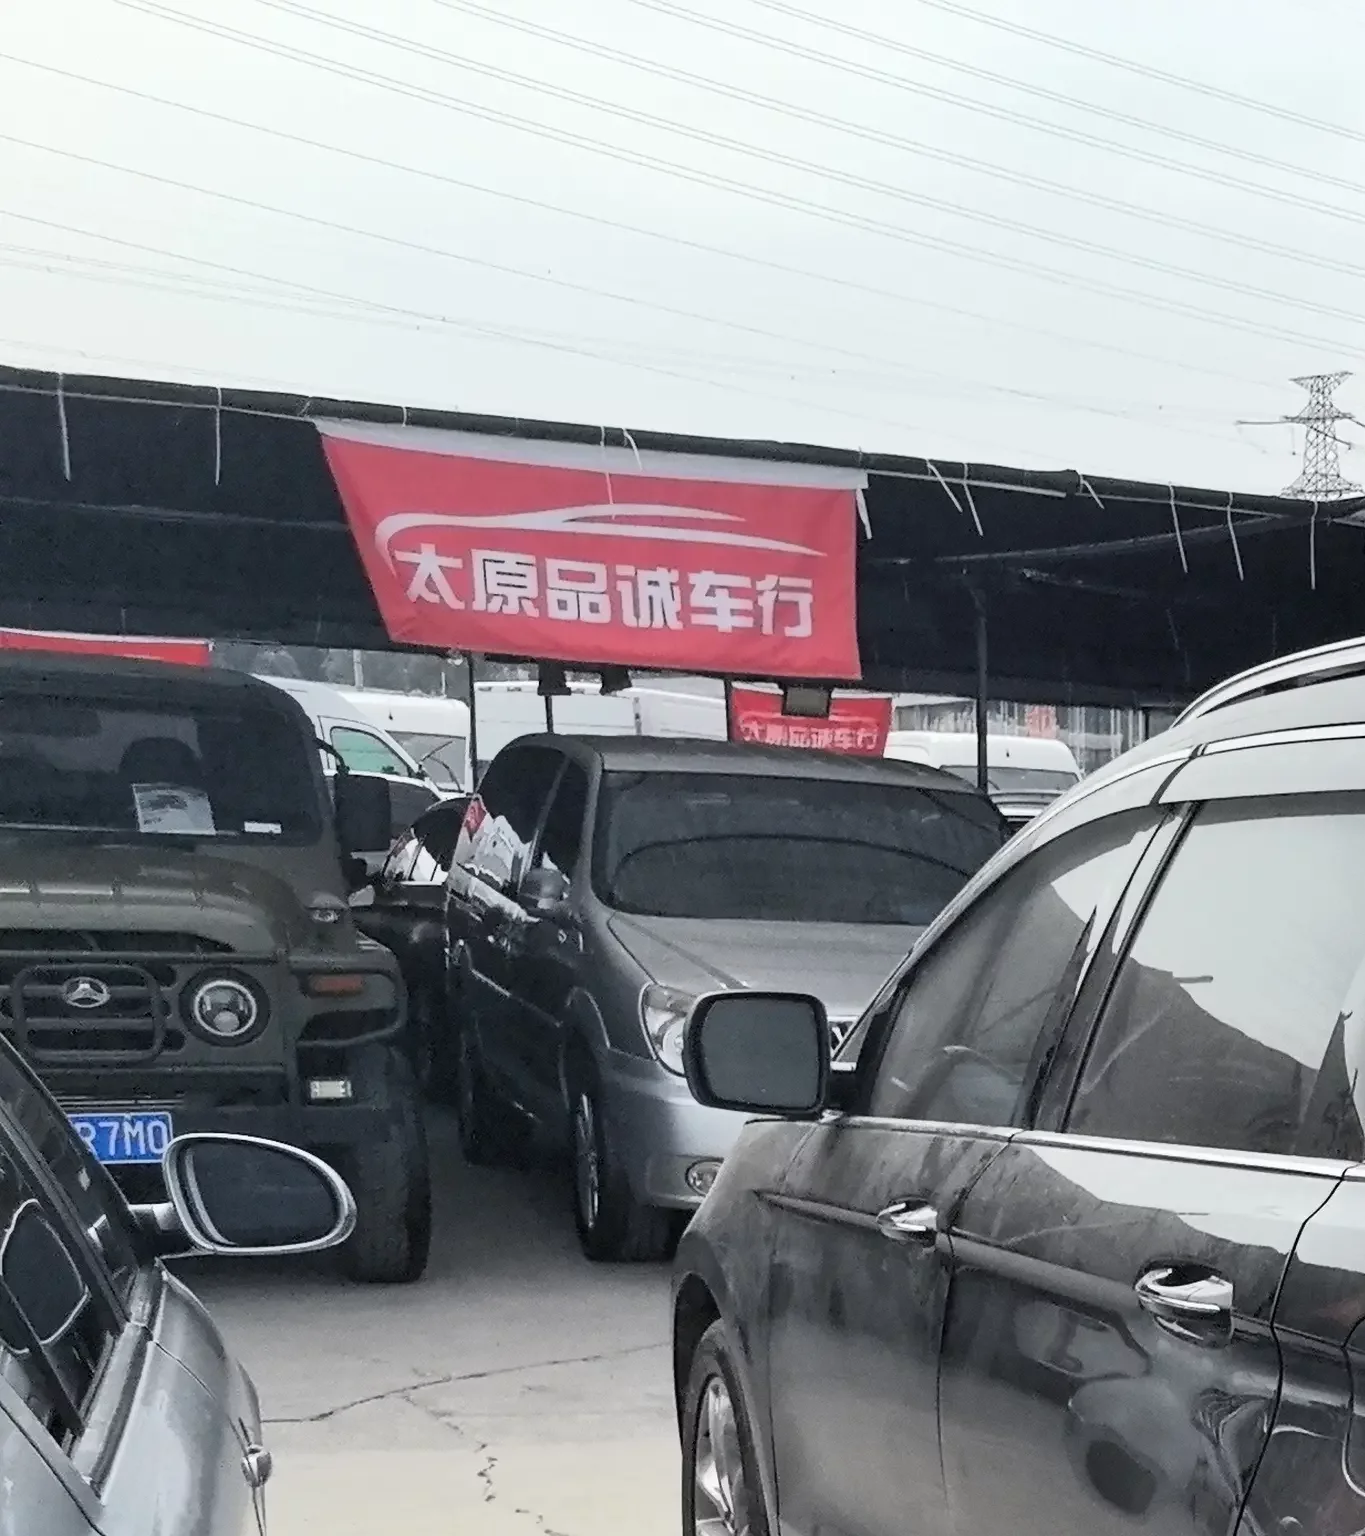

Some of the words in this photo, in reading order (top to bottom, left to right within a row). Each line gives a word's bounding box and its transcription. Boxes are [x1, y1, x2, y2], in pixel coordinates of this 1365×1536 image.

[395, 543, 815, 638] 太原品诚车行
